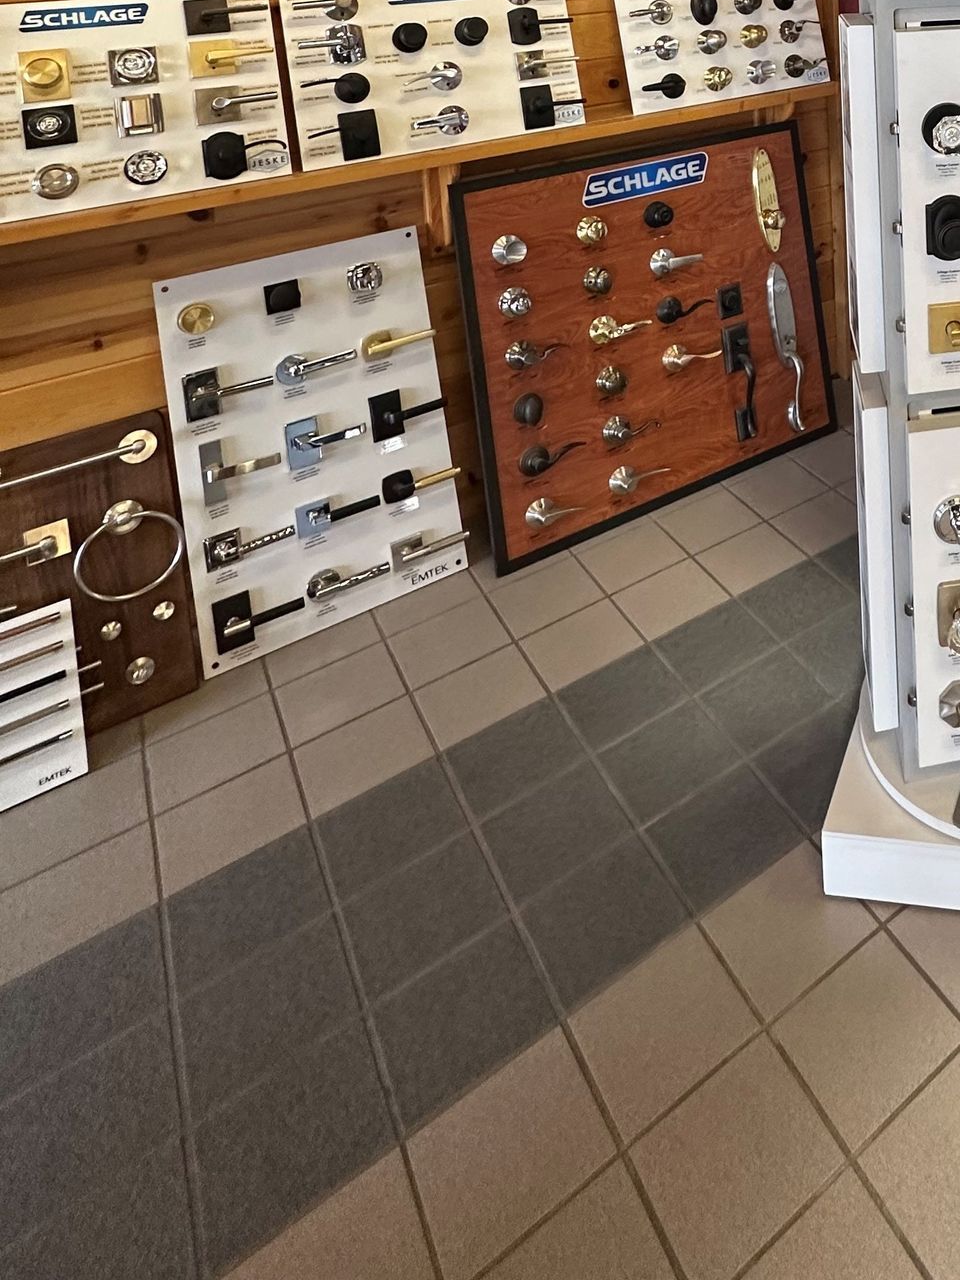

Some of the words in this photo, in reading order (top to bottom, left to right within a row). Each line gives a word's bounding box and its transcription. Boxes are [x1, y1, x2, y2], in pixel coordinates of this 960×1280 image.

[20, 7, 146, 29] SCHLAGE
[557, 108, 581, 119] JESKE
[252, 155, 287, 168] JESKE
[585, 158, 706, 201] SCHLAGE
[411, 563, 449, 585] EMTEK
[39, 766, 72, 786] EMTEK
